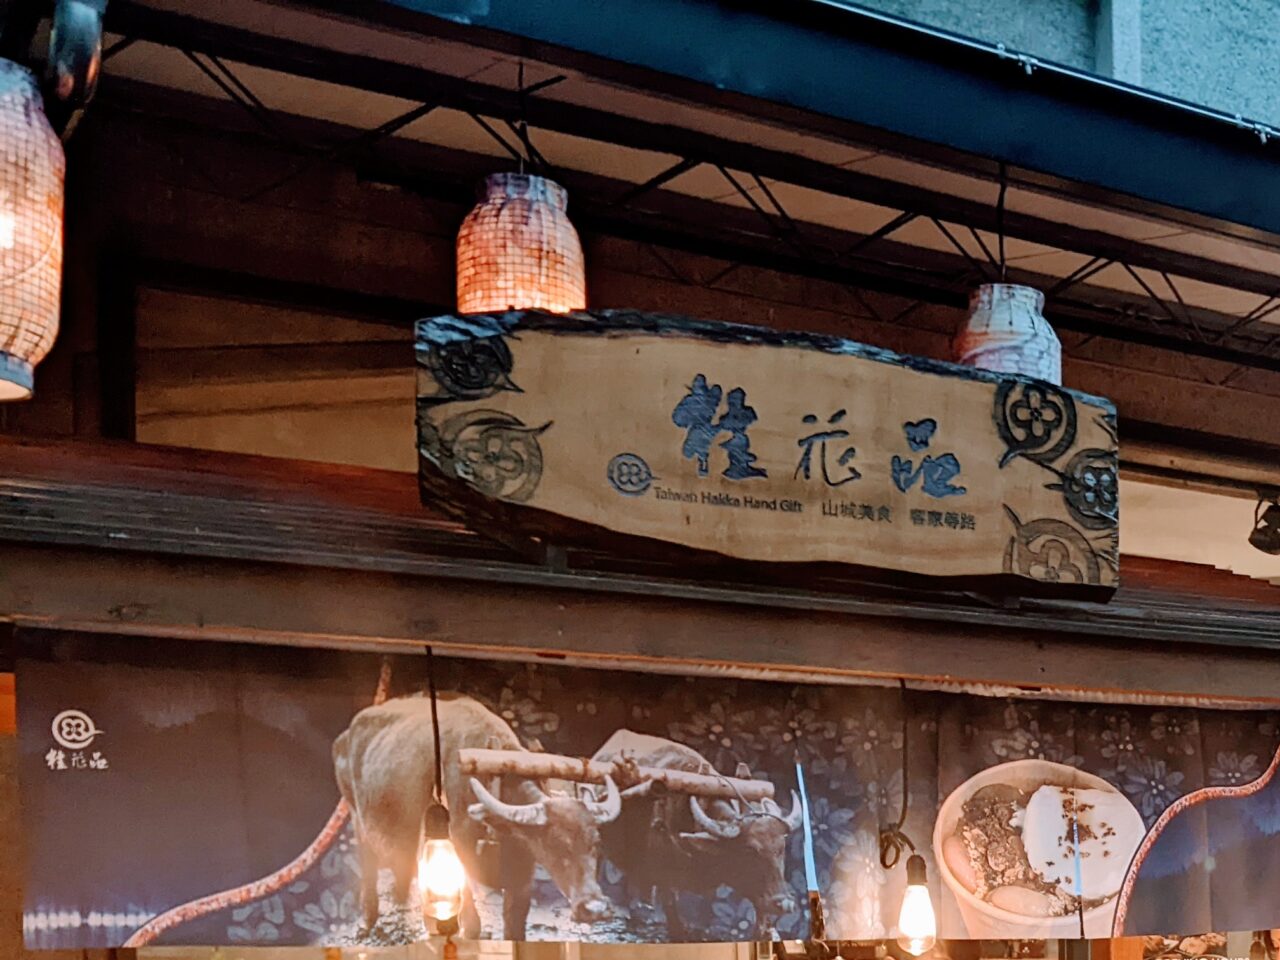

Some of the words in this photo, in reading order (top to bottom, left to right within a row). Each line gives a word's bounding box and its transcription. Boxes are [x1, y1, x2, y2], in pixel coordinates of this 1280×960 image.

[672, 373, 966, 498] 桂花品
[654, 486, 698, 504] Taiwan
[701, 491, 740, 507] Hakka
[743, 496, 777, 511] Hand
[780, 499, 803, 513] Gift
[822, 500, 892, 524] 山城美食
[910, 508, 976, 531] 客家等路
[45, 748, 109, 770] 桂花品
